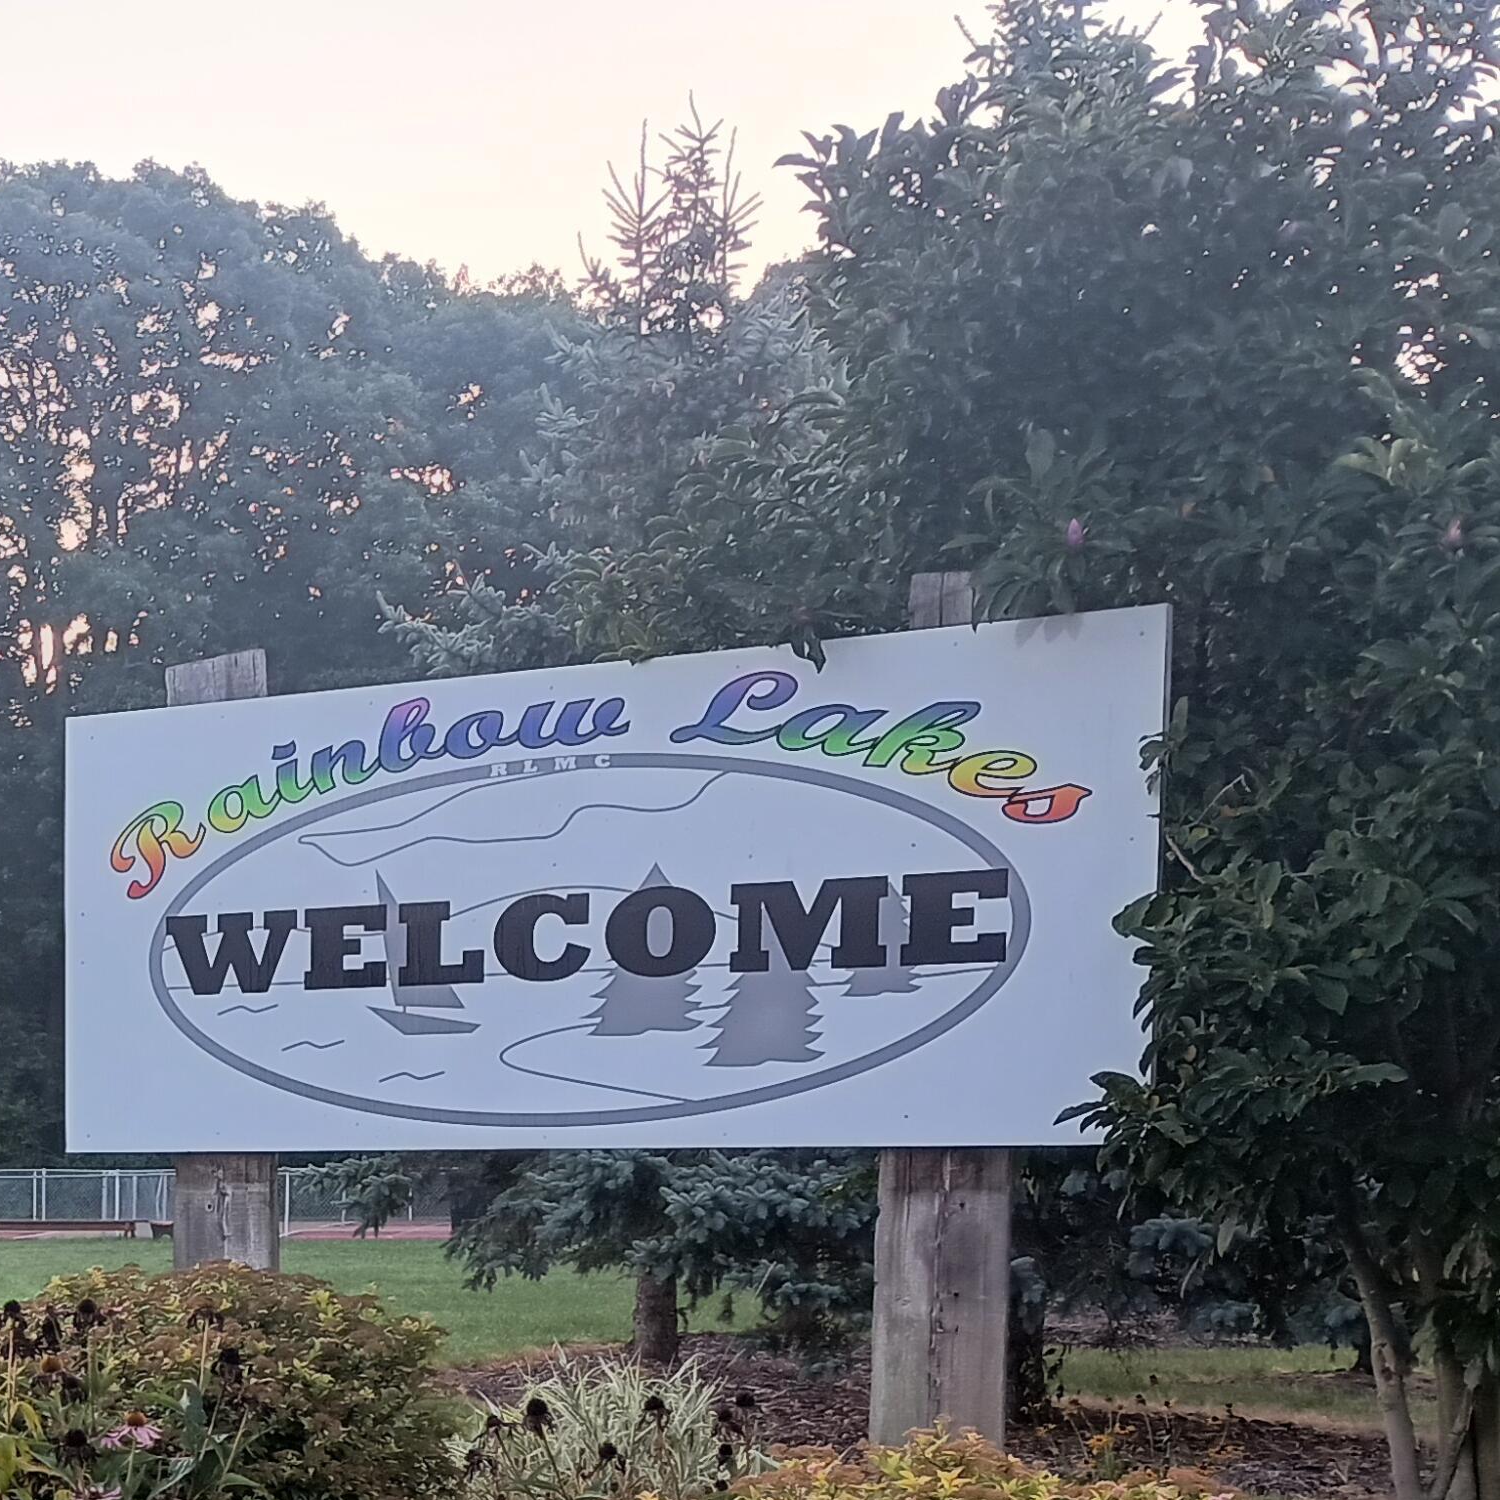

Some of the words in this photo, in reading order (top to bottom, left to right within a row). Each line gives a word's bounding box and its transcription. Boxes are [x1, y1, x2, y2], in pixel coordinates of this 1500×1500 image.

[110, 696, 631, 900] Rainbow
[669, 669, 1093, 825] Lakes
[165, 867, 1009, 996] WELCOME
